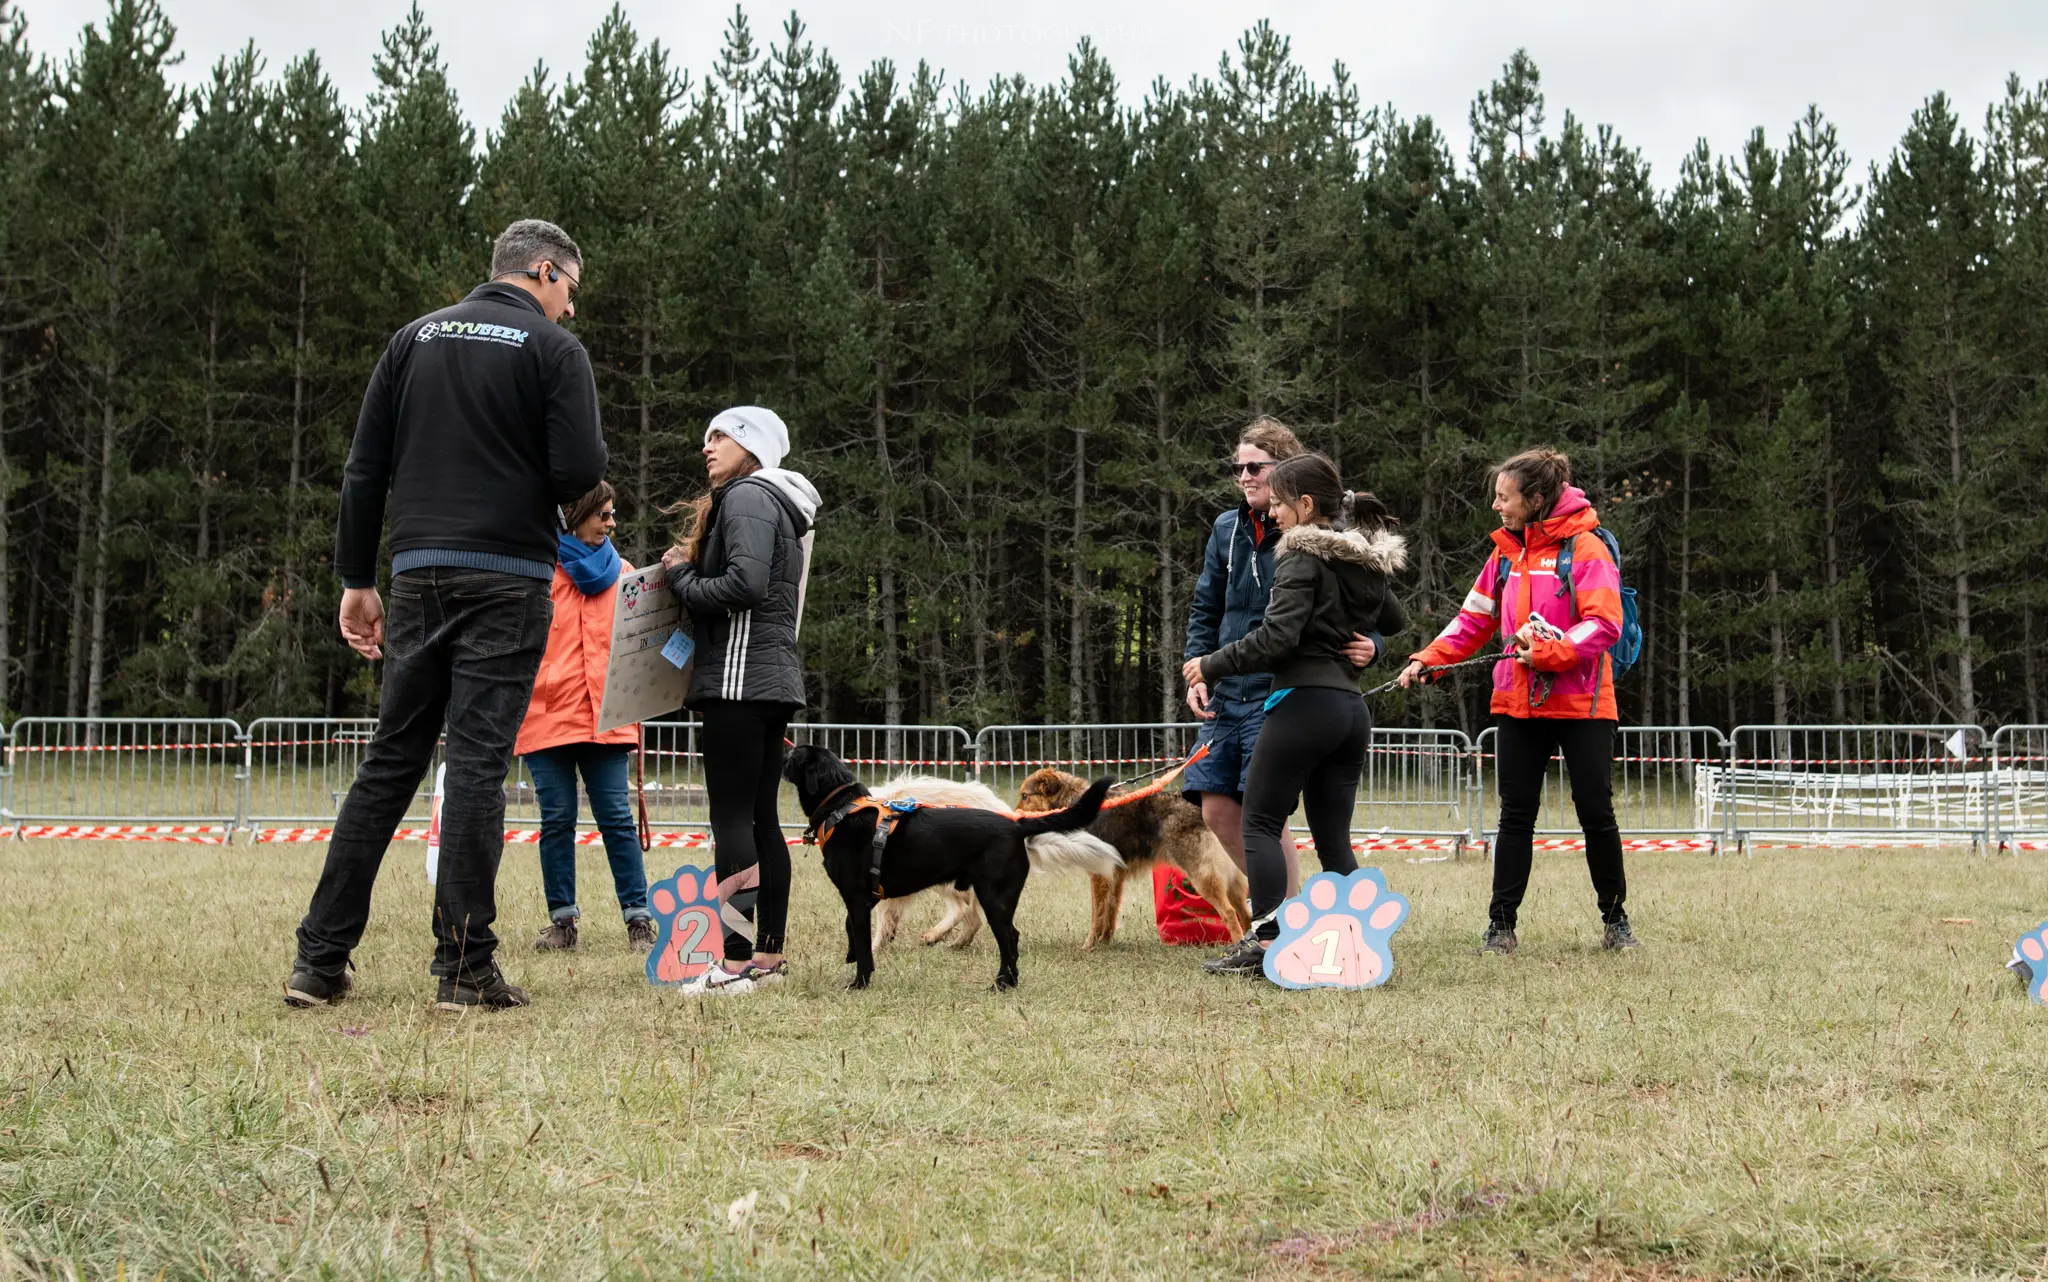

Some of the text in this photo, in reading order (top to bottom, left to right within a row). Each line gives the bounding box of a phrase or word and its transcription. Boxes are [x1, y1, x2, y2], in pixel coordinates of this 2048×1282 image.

[1541, 558, 1557, 568] HH
[677, 910, 715, 965] 2
[1311, 929, 1344, 975] 1
